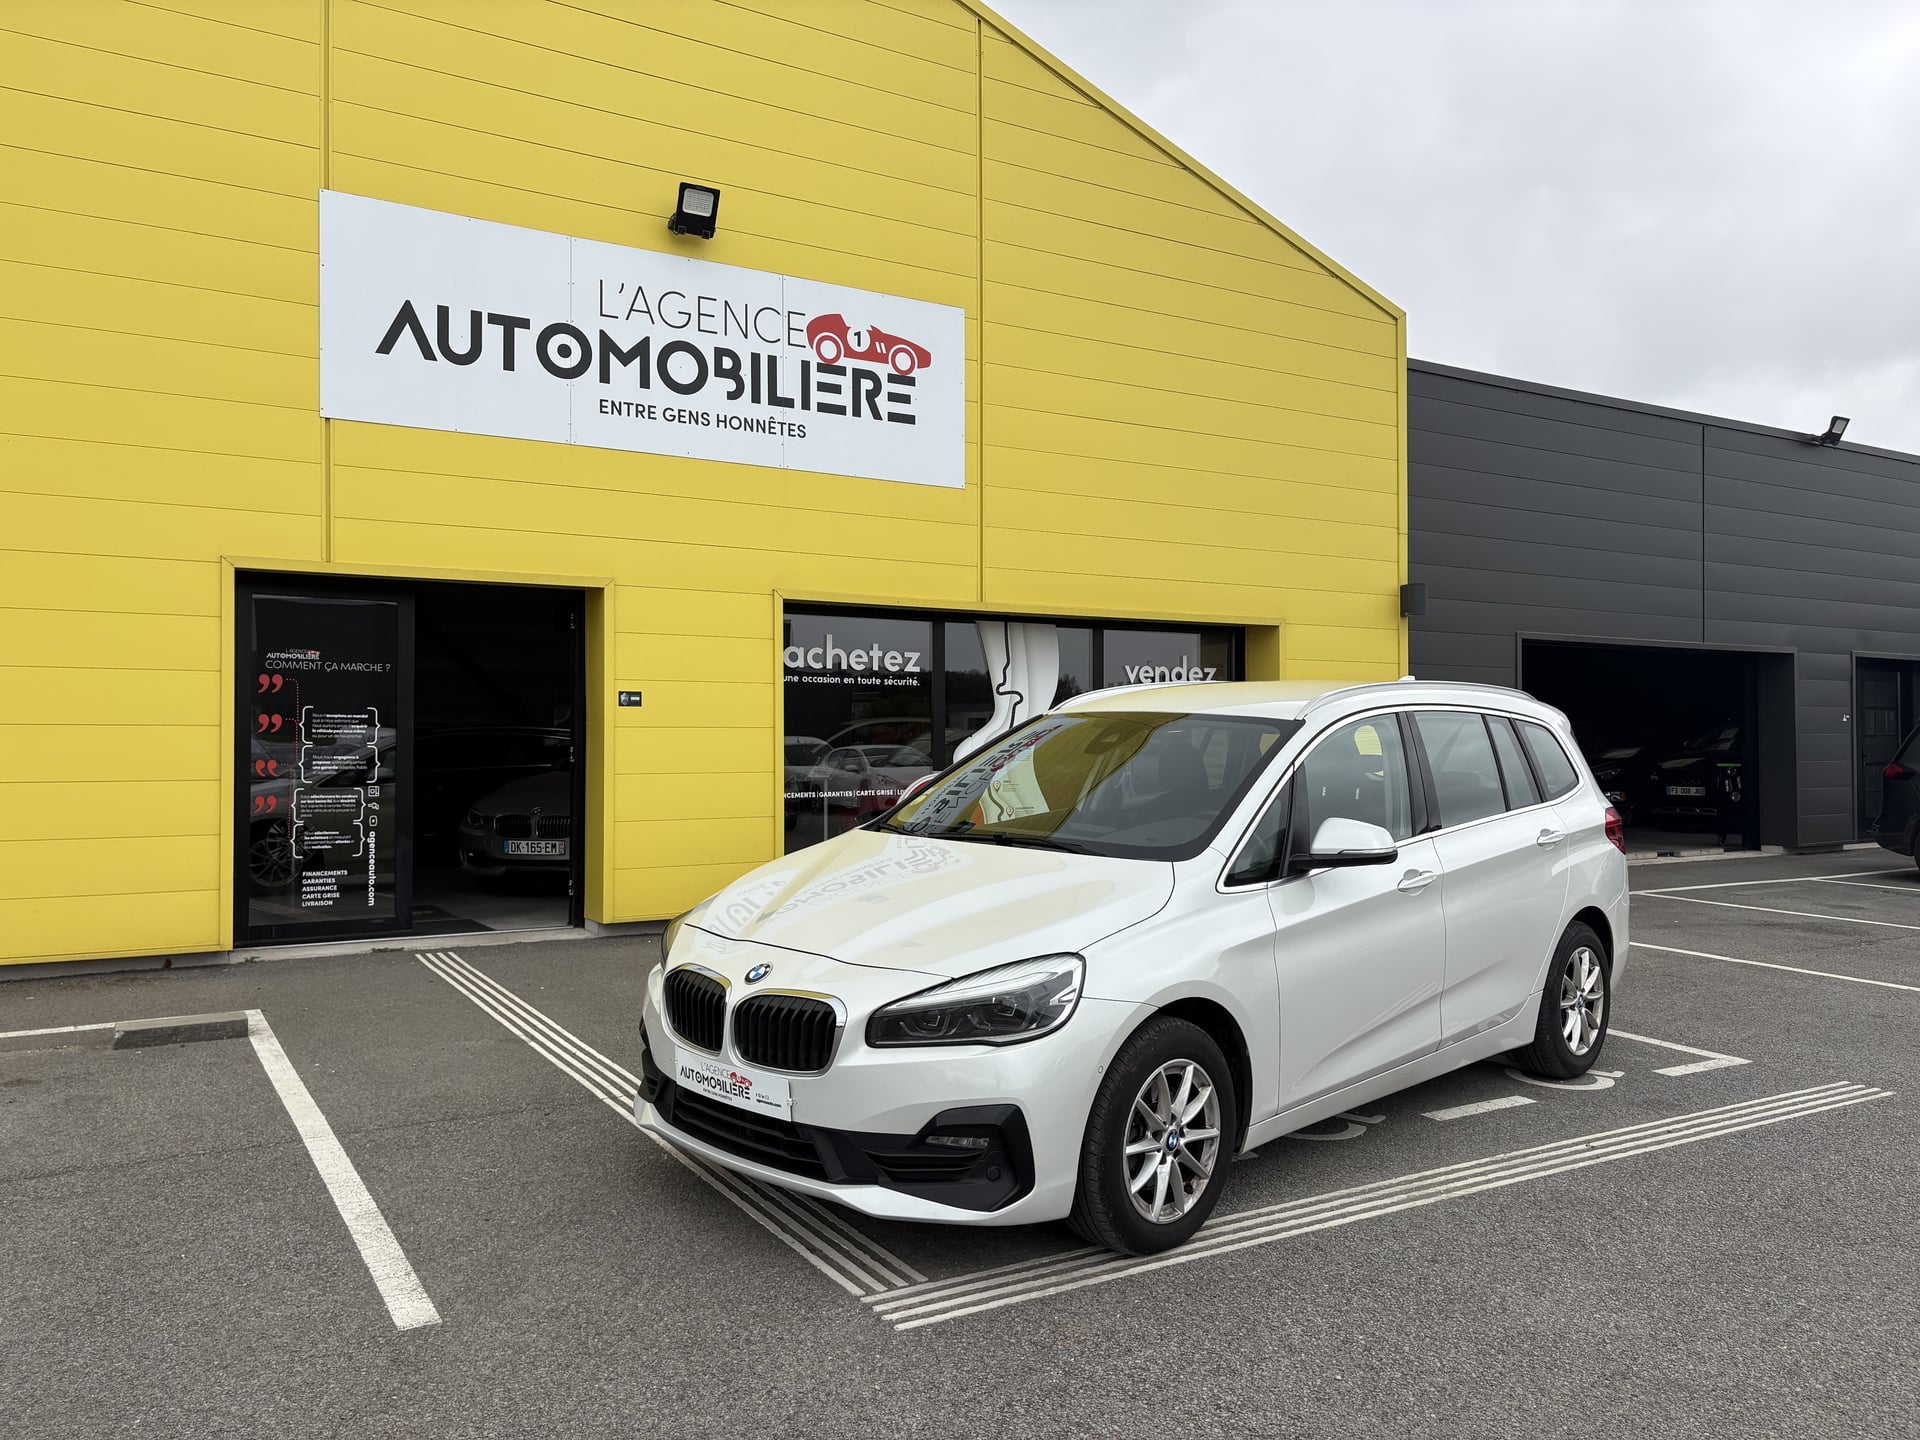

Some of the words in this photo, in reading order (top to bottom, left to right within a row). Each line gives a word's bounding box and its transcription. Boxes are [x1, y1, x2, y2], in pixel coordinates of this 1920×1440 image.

[599, 279, 806, 348] L'AGENCE
[599, 398, 657, 420] ENTRE
[662, 407, 710, 426] GENS
[716, 415, 807, 438] HONNÊTES
[265, 660, 322, 670] COMMENT
[324, 662, 338, 672] ÇA
[340, 663, 383, 672] MARCHE
[385, 664, 391, 672] ?
[783, 634, 921, 672] achetez
[1124, 655, 1217, 683] vendez
[802, 674, 841, 684] occasion
[857, 675, 881, 685] toute
[884, 675, 920, 686] sécurité.
[367, 830, 376, 907] agenceauto.com
